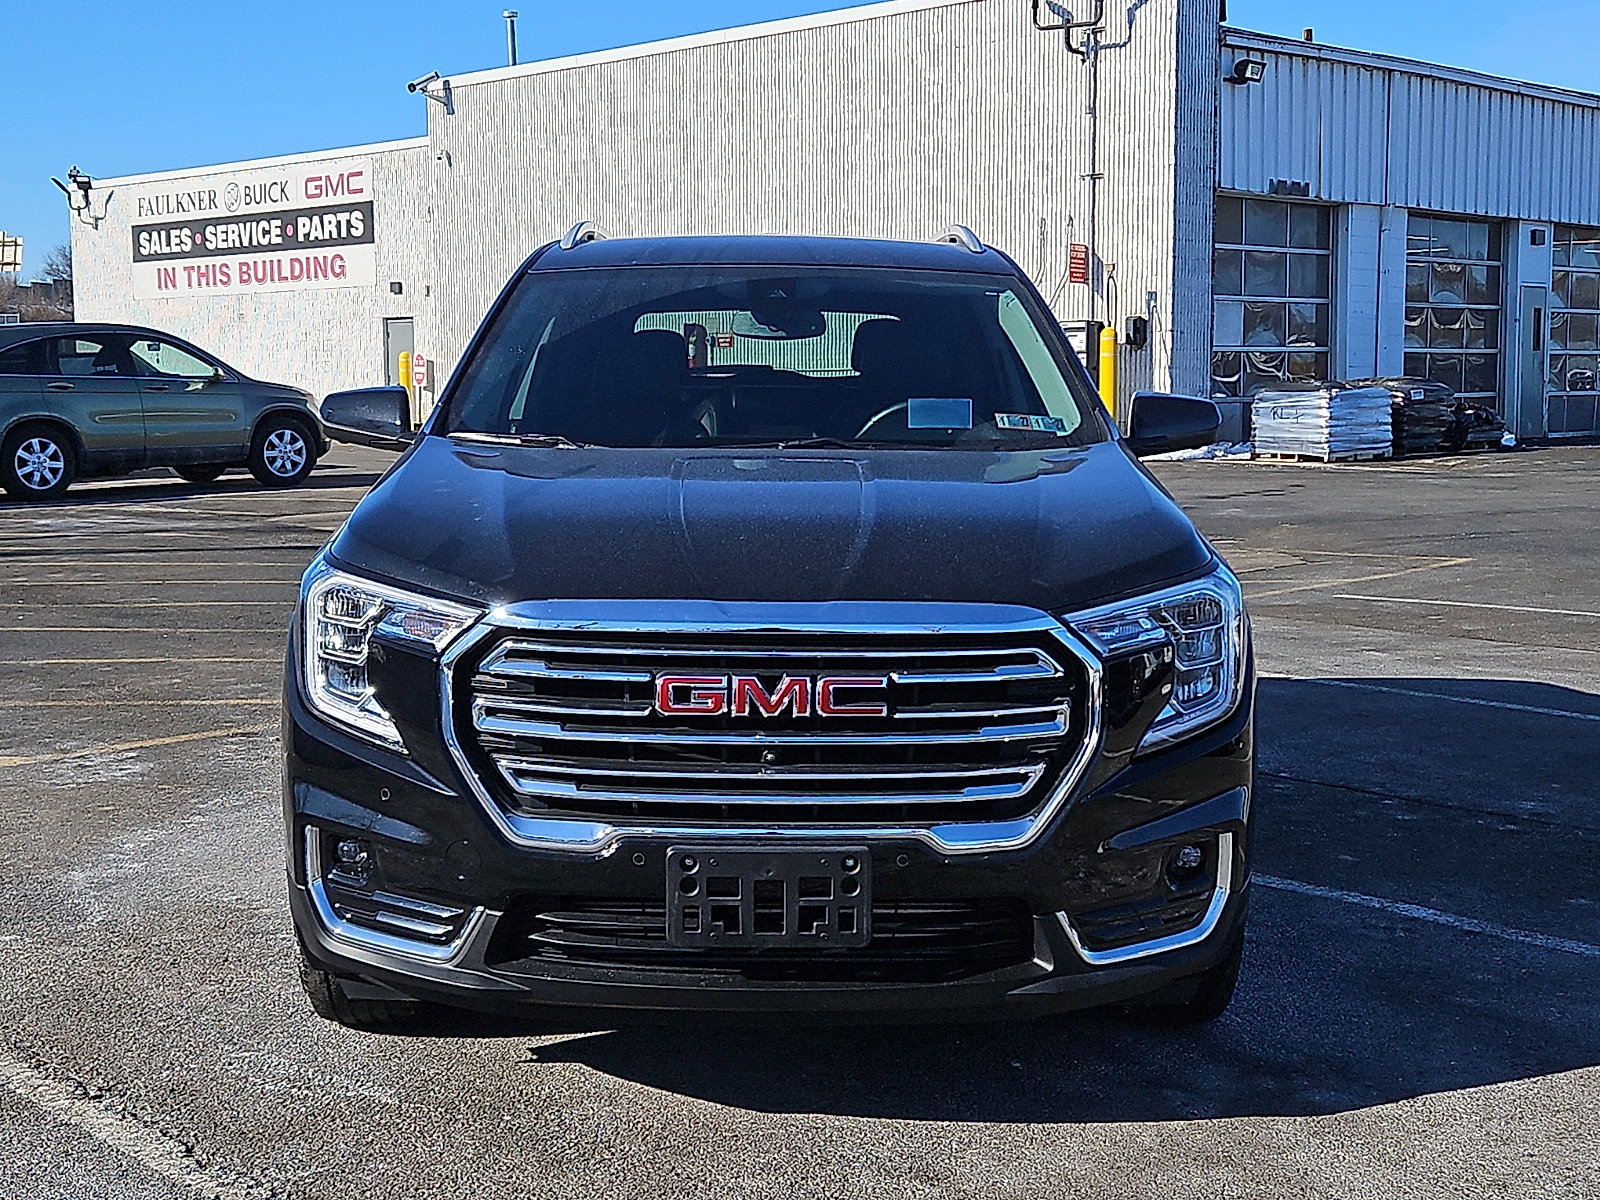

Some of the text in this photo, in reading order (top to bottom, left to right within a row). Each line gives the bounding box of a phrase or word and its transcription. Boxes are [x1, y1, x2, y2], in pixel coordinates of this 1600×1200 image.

[138, 171, 364, 217] FAULKNER BUICK GMC
[139, 210, 365, 256] SALES SERVICE PARTS
[157, 254, 346, 290] IN THIS BUILDING
[655, 674, 887, 717] GMC
